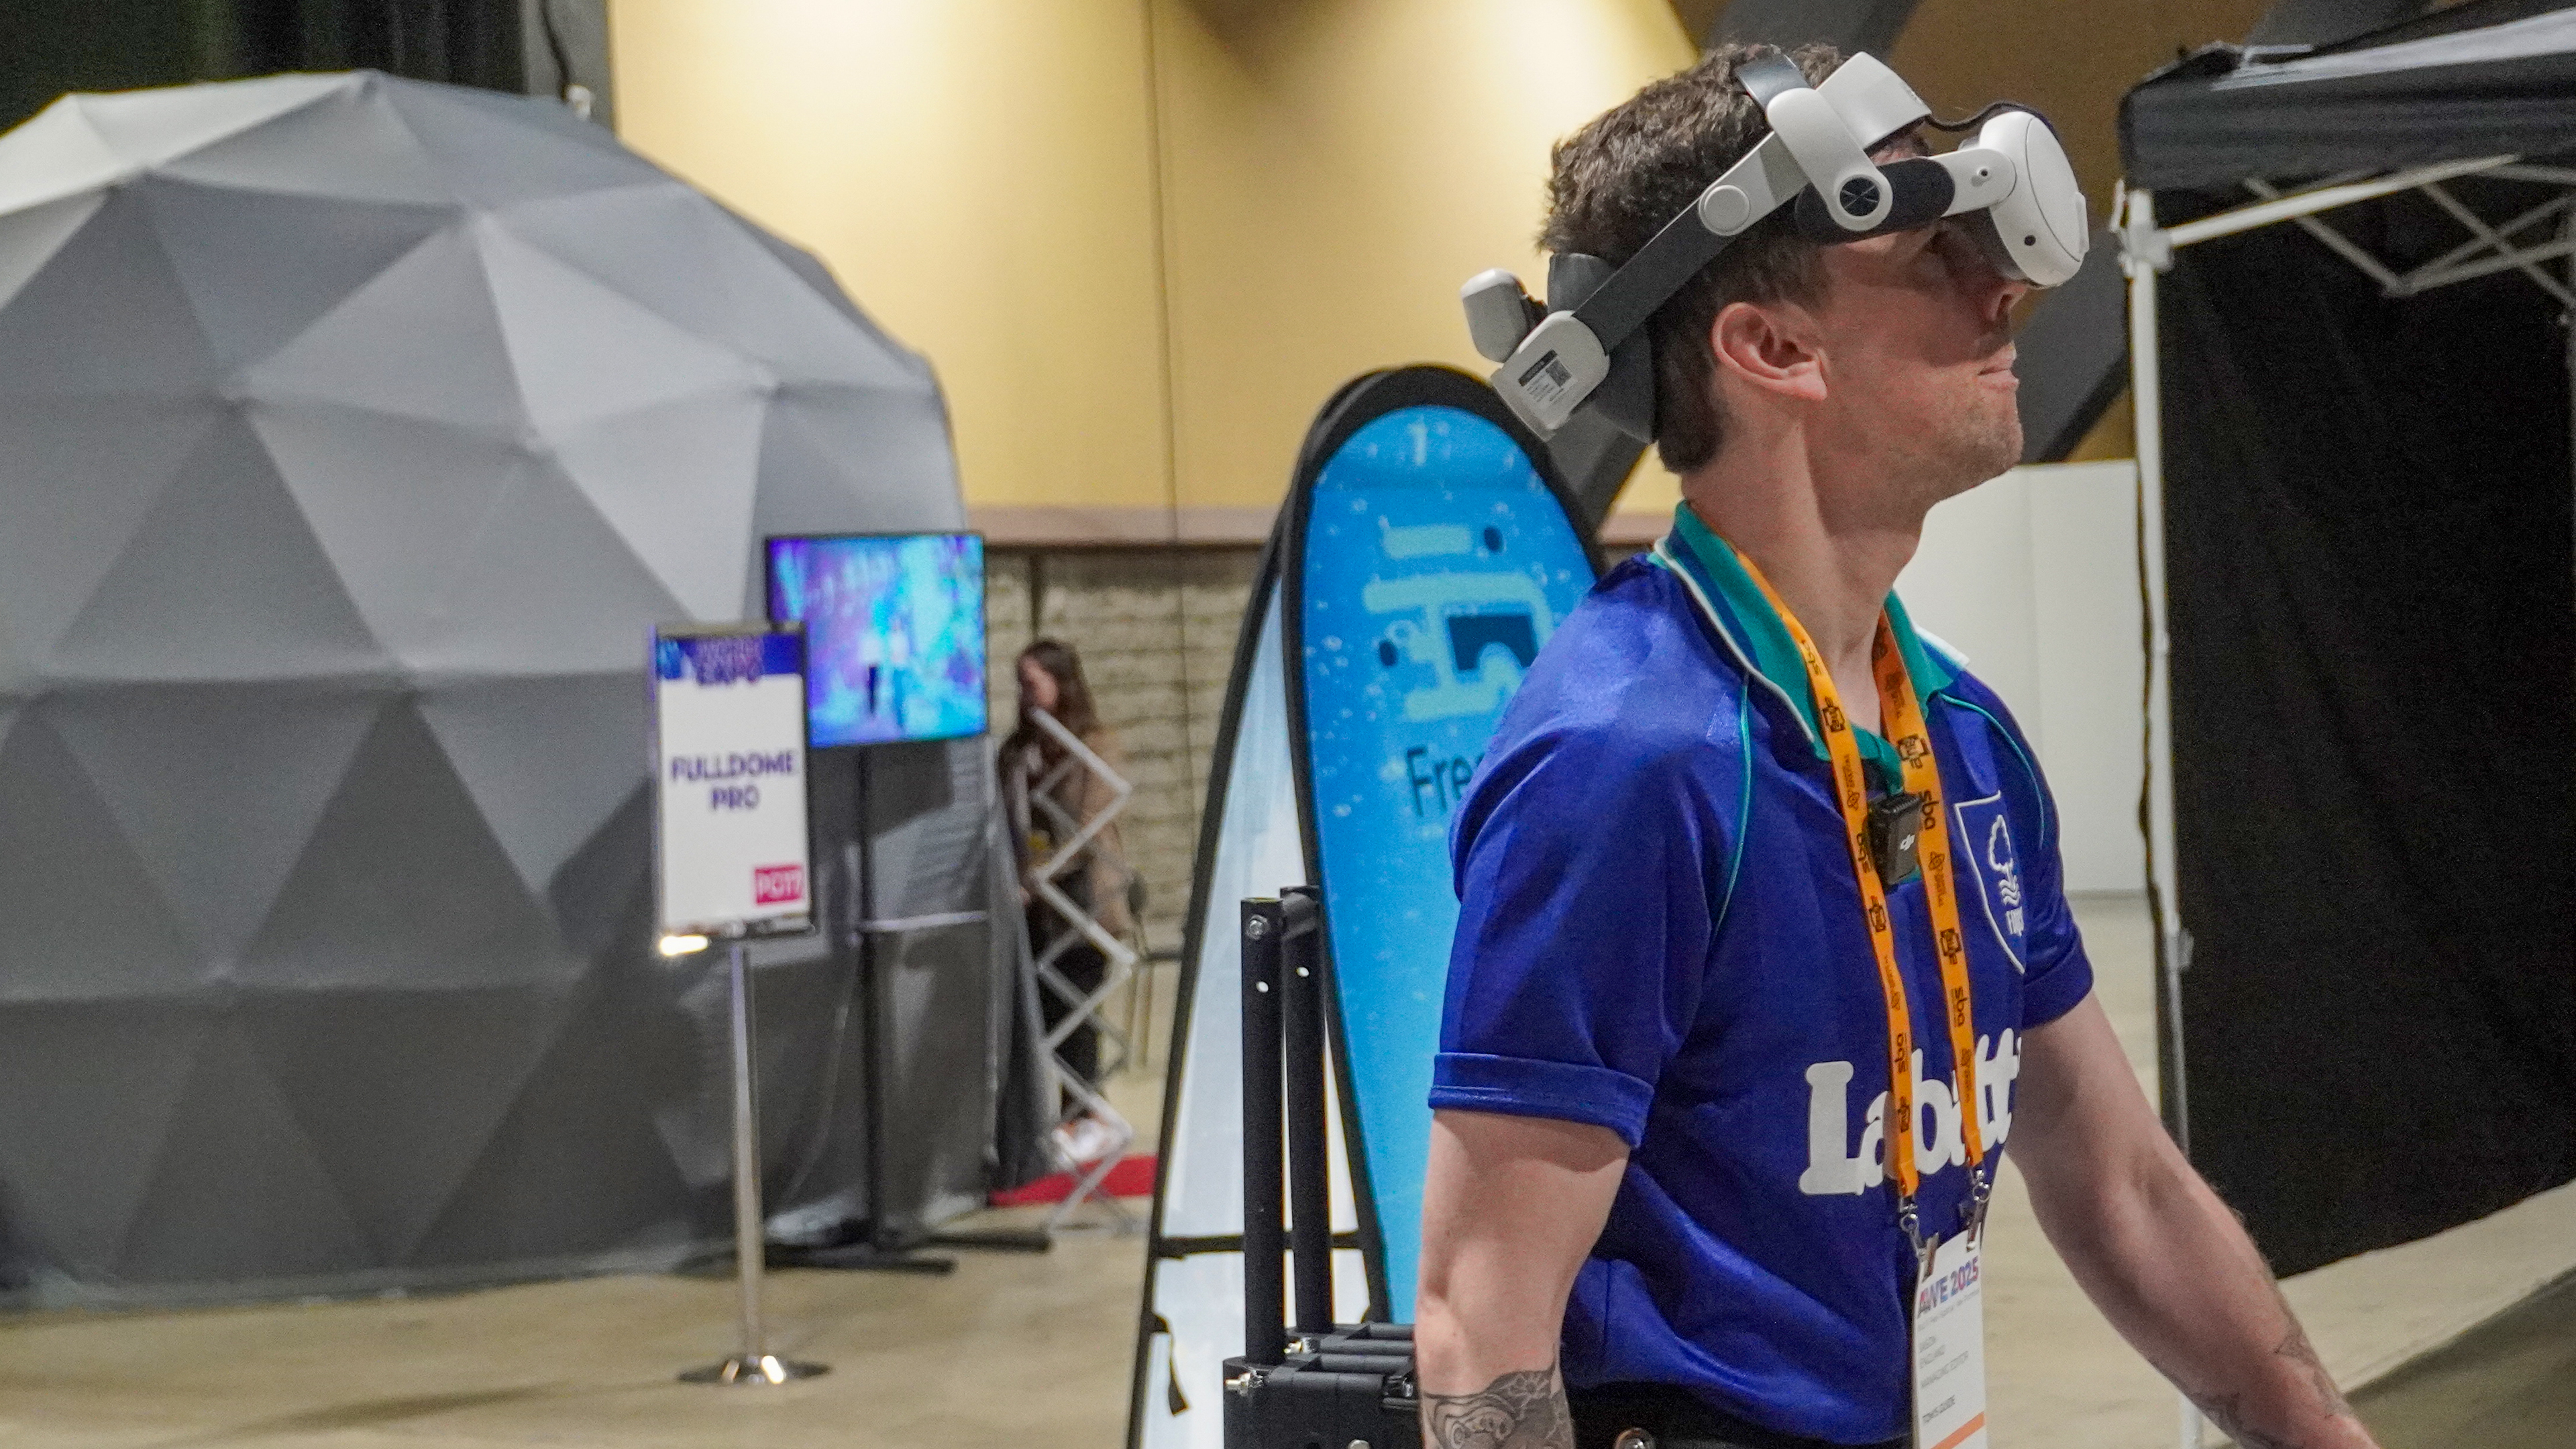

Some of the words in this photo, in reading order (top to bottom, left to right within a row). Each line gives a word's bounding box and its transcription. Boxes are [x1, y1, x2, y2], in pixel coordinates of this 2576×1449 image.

[672, 750, 796, 781] FULLDOME
[1407, 745, 1485, 817] Fre
[711, 785, 759, 810] PRO
[1799, 1027, 2021, 1195] Labtt
[1951, 1255, 1978, 1296] 2025
